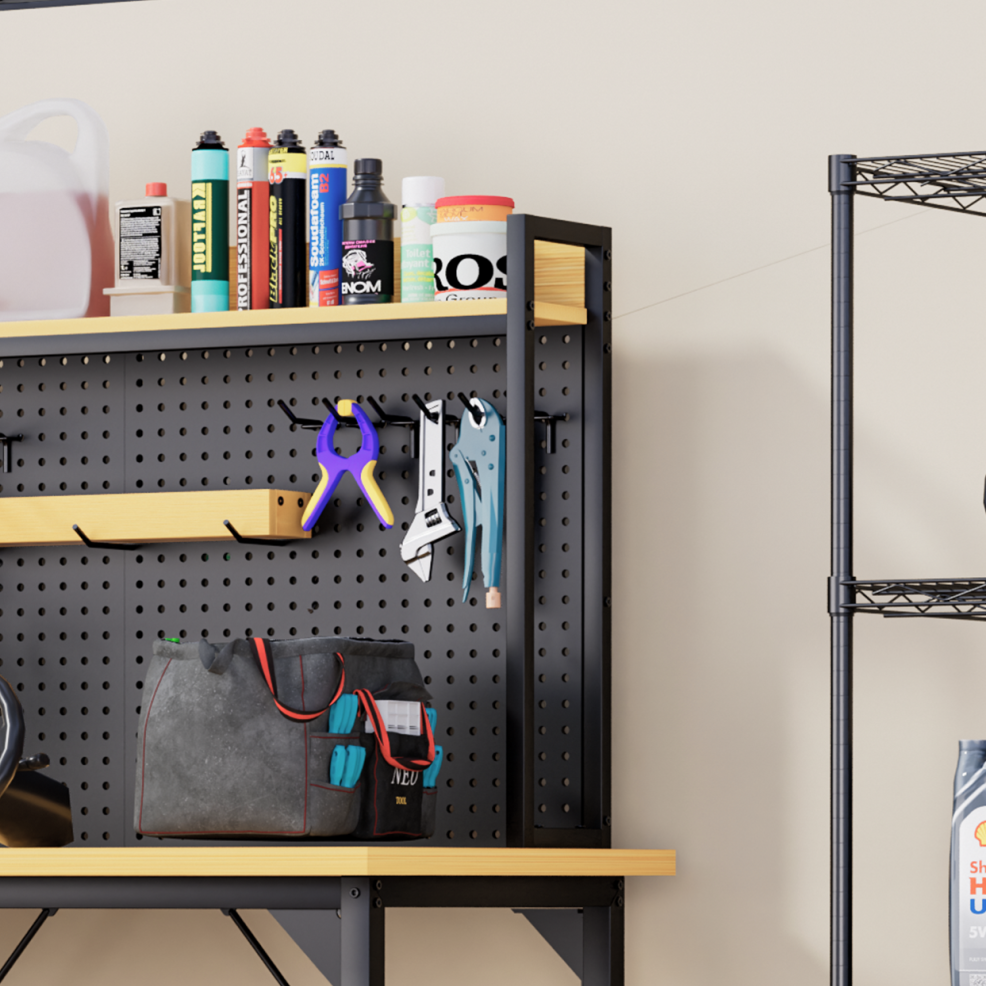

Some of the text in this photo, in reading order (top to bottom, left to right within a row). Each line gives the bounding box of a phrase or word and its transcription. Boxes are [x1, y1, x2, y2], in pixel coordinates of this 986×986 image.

[319, 173, 330, 193] B2
[310, 173, 319, 267] Soudafoam
[405, 248, 431, 258] Toilet
